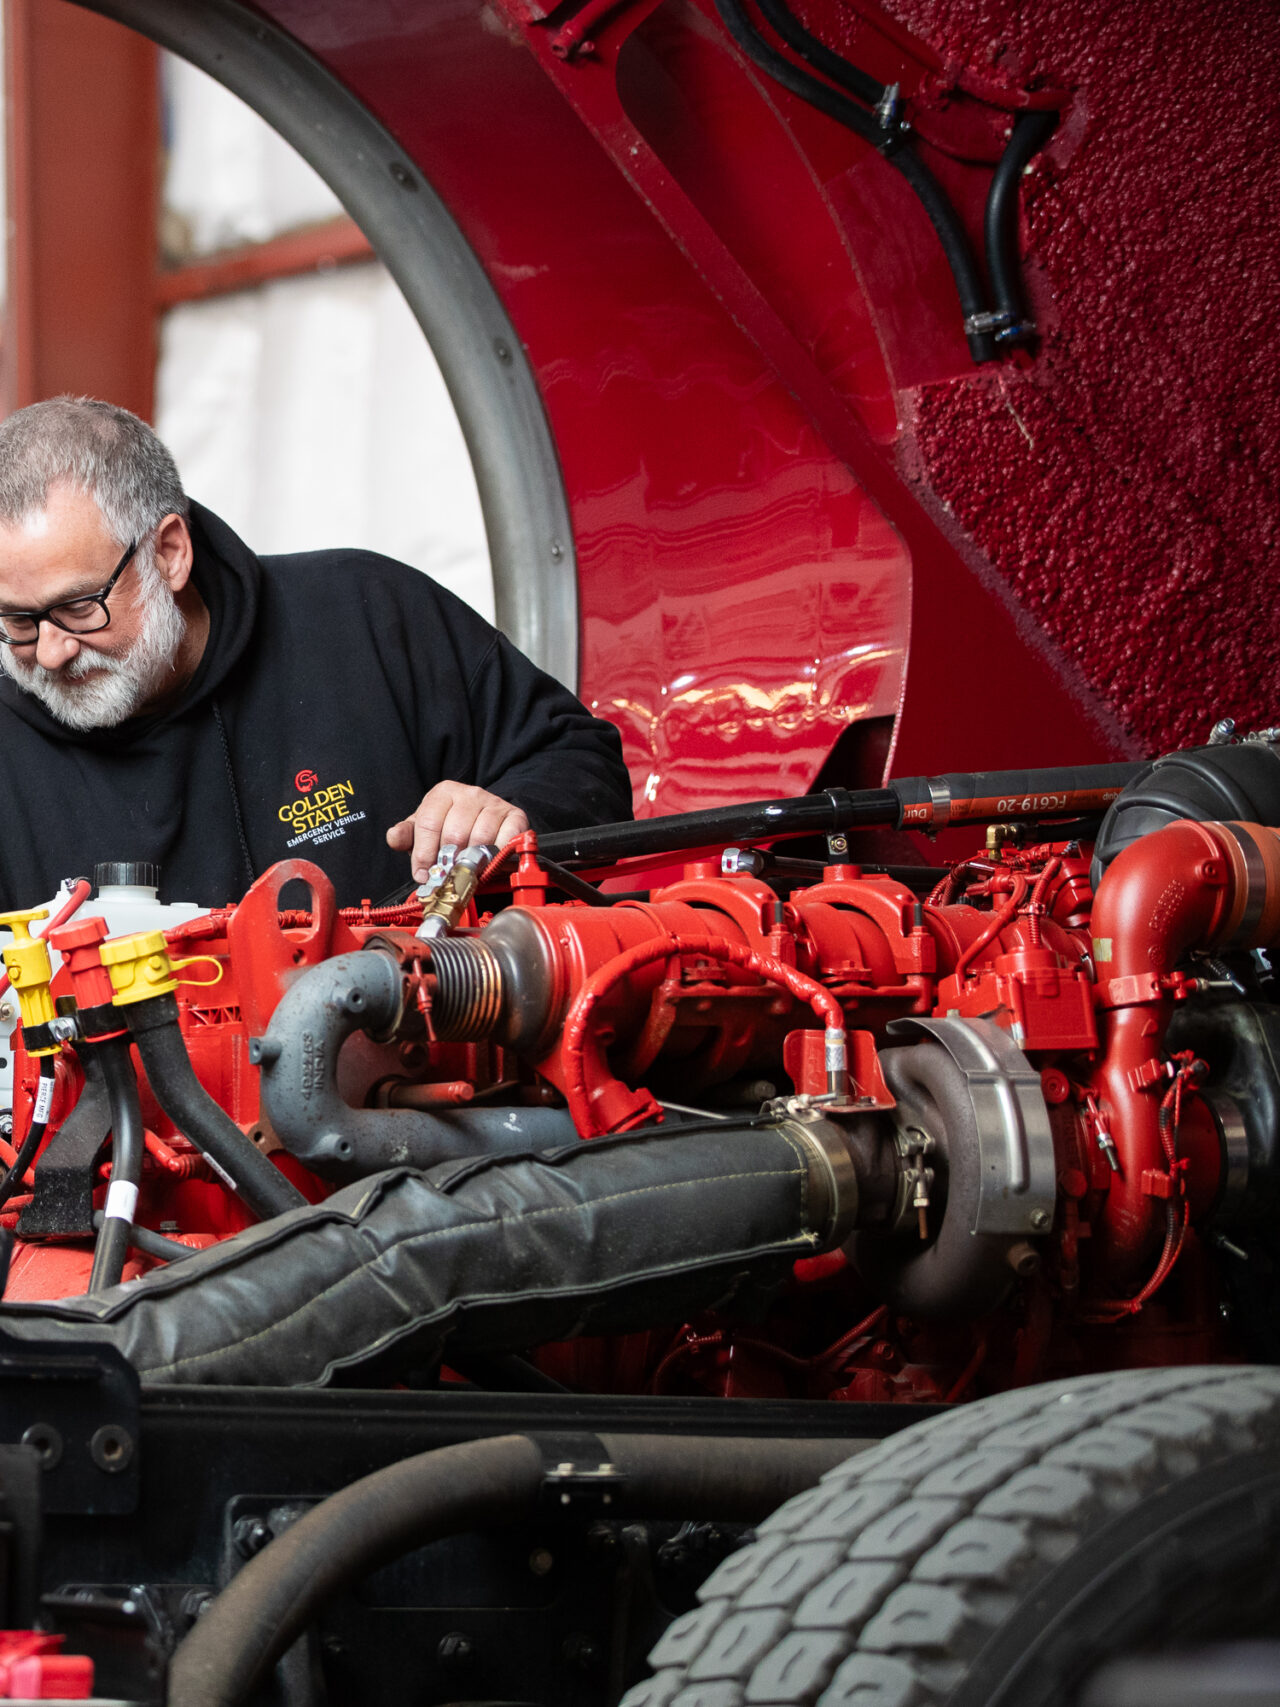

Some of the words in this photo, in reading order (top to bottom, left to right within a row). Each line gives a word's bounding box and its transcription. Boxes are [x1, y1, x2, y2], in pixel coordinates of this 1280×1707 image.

[278, 780, 355, 822] GOLDEN
[292, 800, 350, 834] STATE
[997, 794, 1067, 813] FC619-20
[286, 822, 333, 848] EMERGENCY
[333, 811, 366, 828] VEHICLE
[312, 827, 346, 845] SERVICE
[313, 1040, 325, 1090] INDIA
[36, 1105, 45, 1118] MFG
